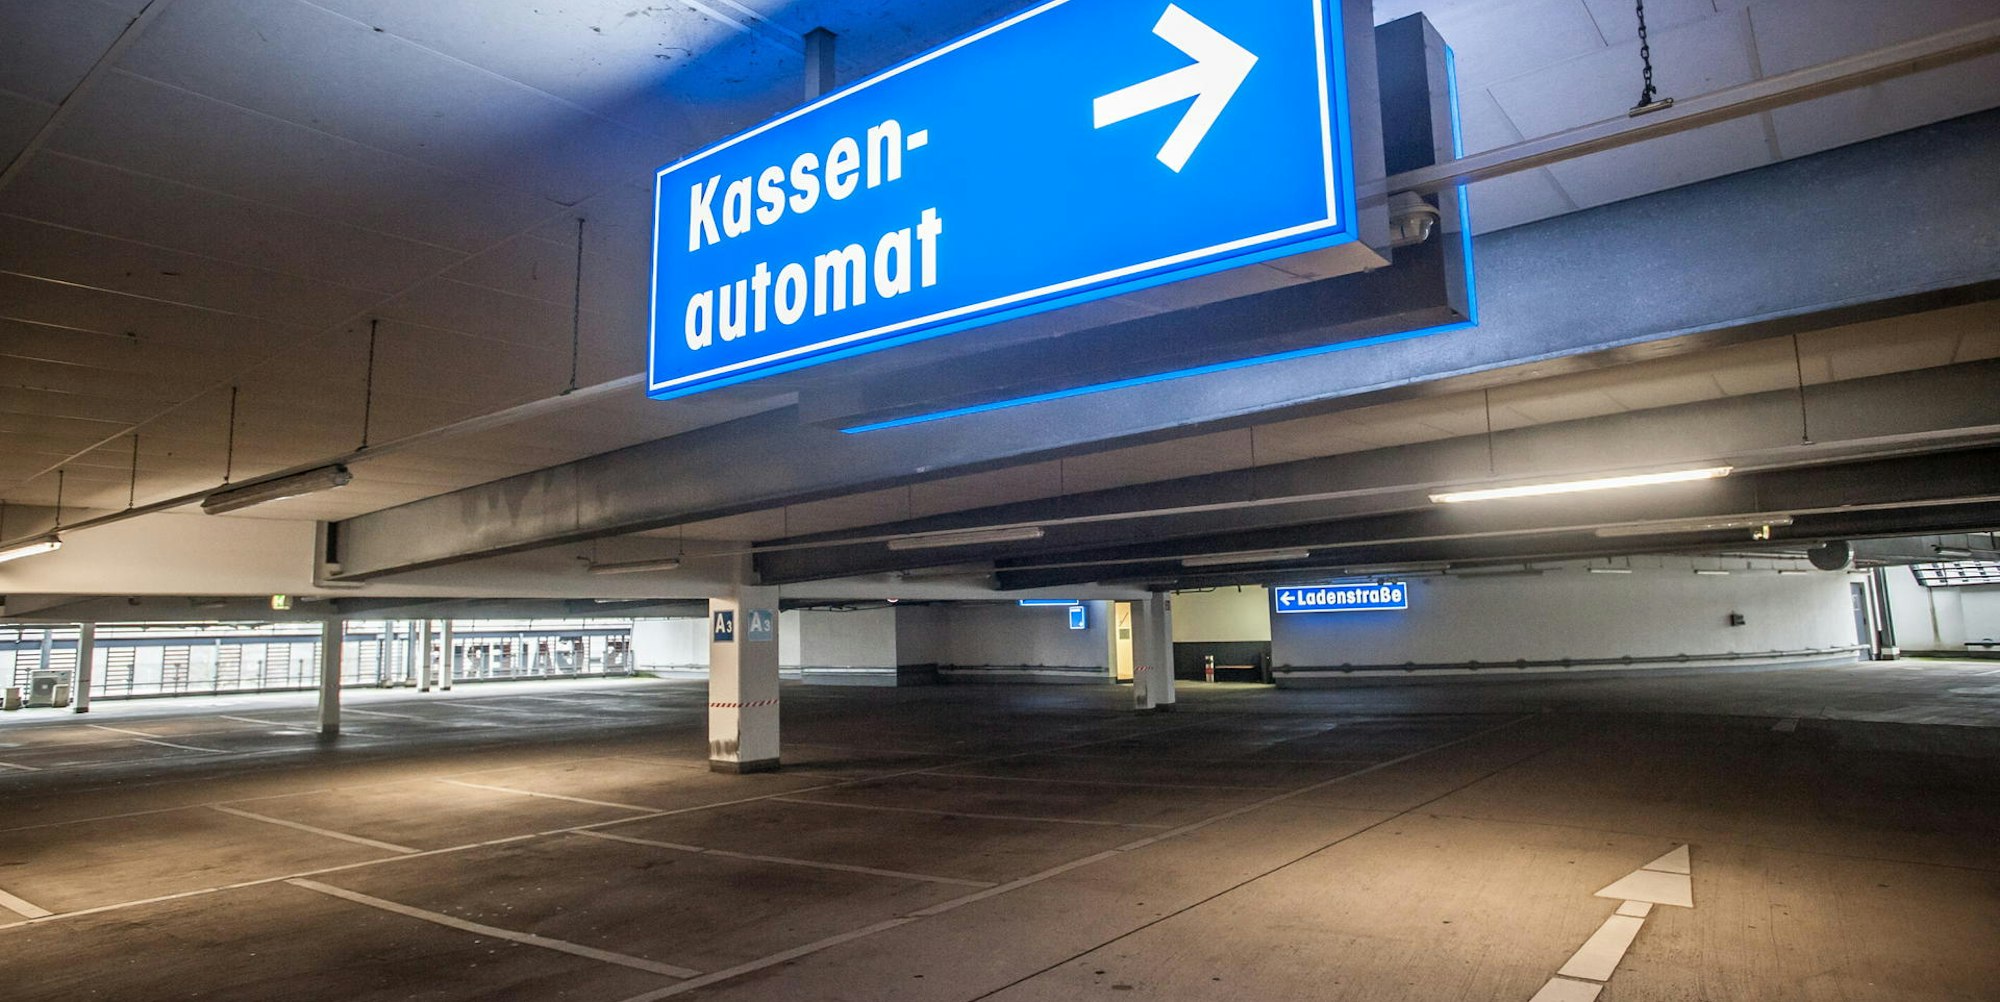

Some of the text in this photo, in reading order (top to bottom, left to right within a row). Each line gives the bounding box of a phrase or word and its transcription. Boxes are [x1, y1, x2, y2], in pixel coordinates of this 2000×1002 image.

[688, 119, 928, 252] Kassen-
[684, 207, 943, 351] automat
[1297, 587, 1402, 606] Ladenstraße
[715, 613, 732, 633] A3
[750, 611, 771, 632] A3
